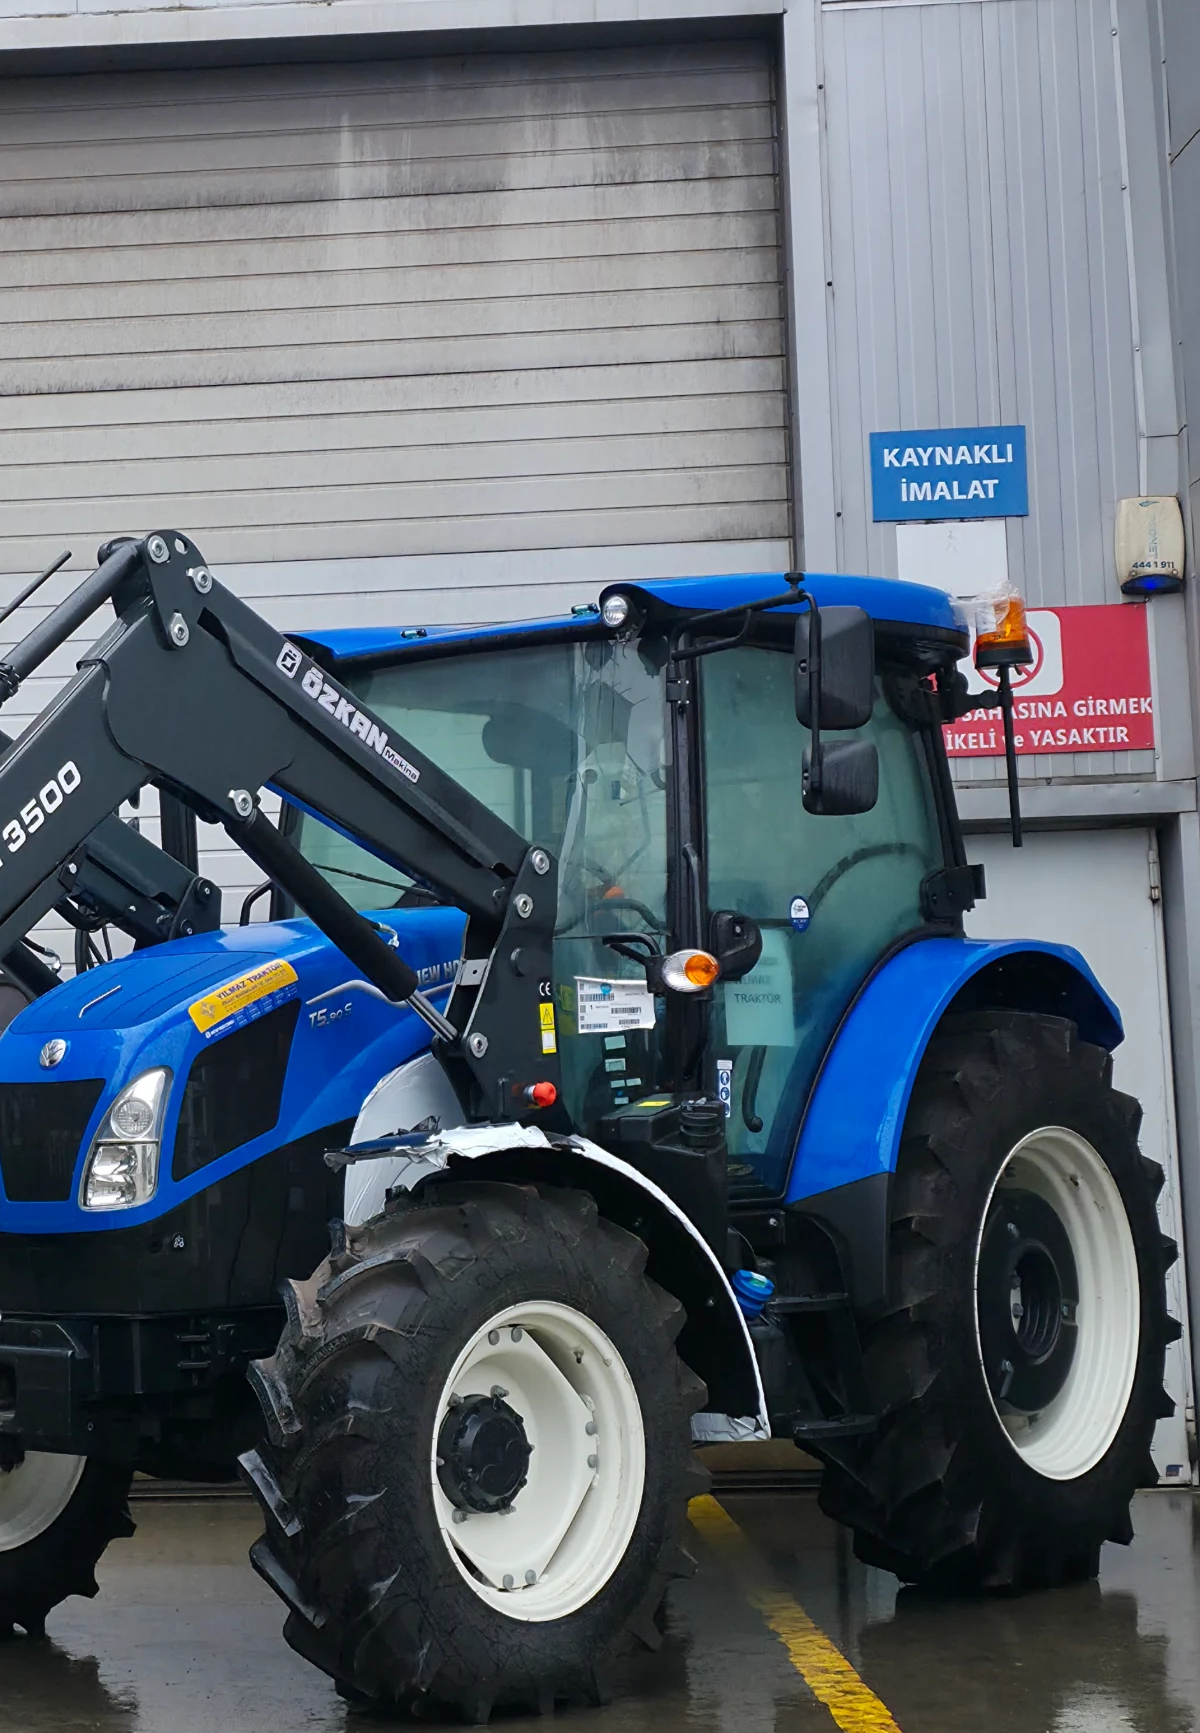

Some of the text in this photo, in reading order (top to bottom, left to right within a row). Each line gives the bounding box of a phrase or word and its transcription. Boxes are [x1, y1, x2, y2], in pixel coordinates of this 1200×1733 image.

[883, 443, 1013, 468] KAYNAKLI
[901, 478, 999, 502] İMALAT
[1073, 696, 1153, 716] GİRMEK
[301, 666, 389, 755] ÖZKAN
[384, 749, 418, 781] Makina
[1029, 726, 1130, 747] YASAKTIR
[2, 760, 81, 853] 3500
[215, 980, 247, 1000] YILMAZ
